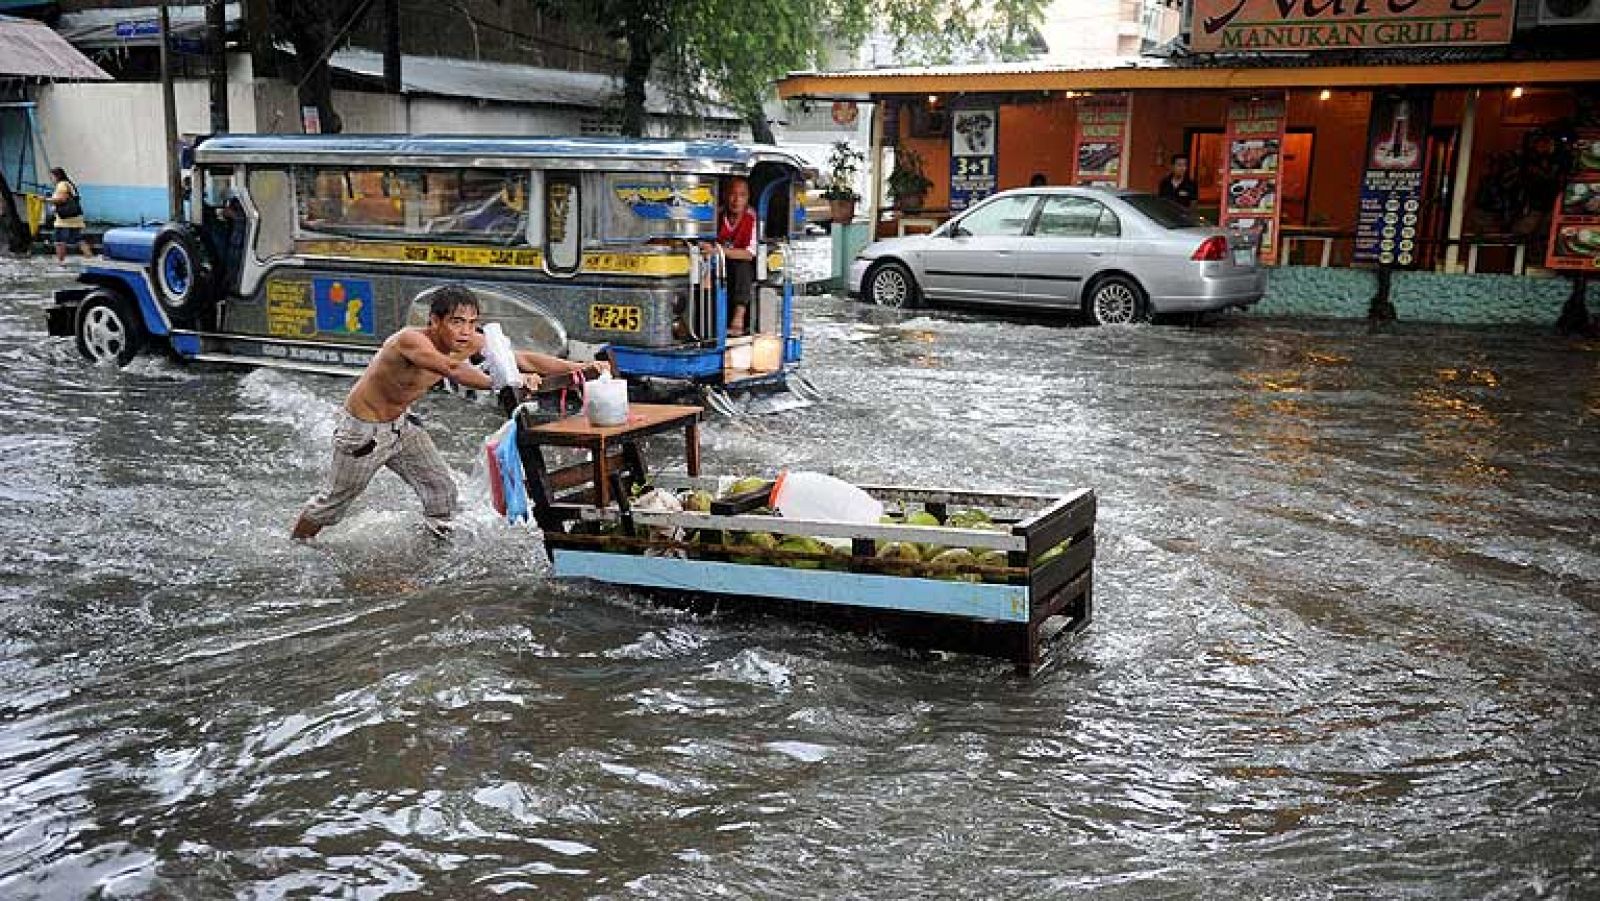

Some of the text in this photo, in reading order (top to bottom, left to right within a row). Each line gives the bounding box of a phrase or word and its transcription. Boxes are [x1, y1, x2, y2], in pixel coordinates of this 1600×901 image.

[1220, 20, 1478, 48] MANUKAN GRILLE
[957, 158, 991, 175] 3+1
